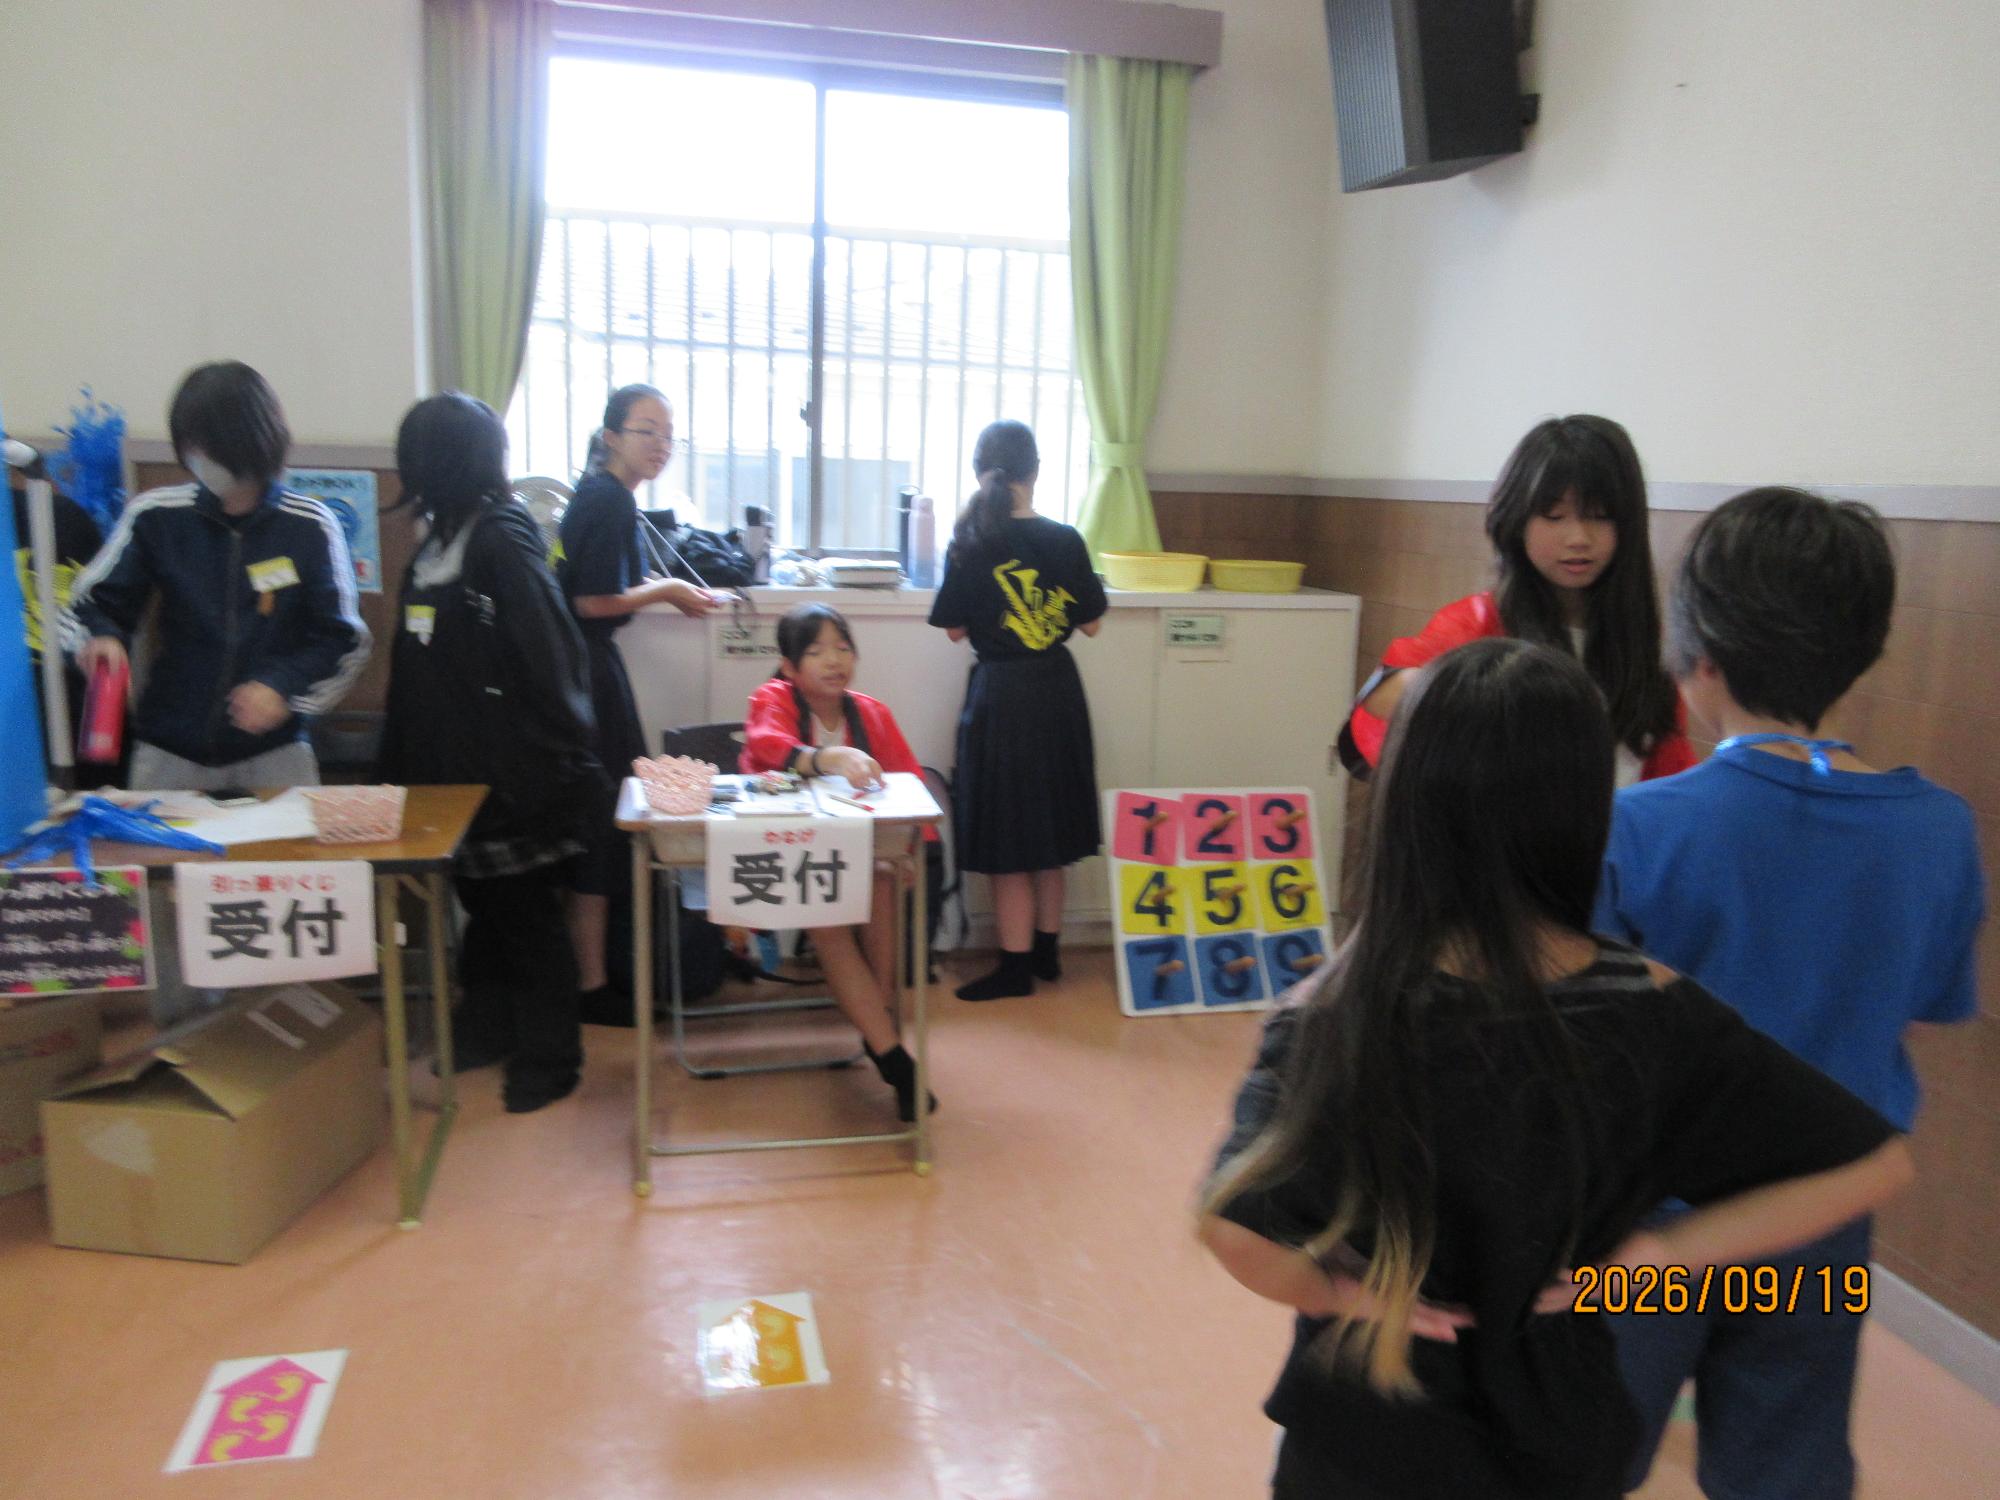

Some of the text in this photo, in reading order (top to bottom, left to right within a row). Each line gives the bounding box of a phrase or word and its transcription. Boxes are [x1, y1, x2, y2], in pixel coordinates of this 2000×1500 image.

[1132, 798, 1299, 856] 1 2 3
[733, 850, 847, 905] 受付
[1134, 865, 1307, 927] 4 5 6
[210, 898, 344, 960] 受付
[1135, 941, 1176, 1000] 7
[1210, 939, 1250, 997] 8
